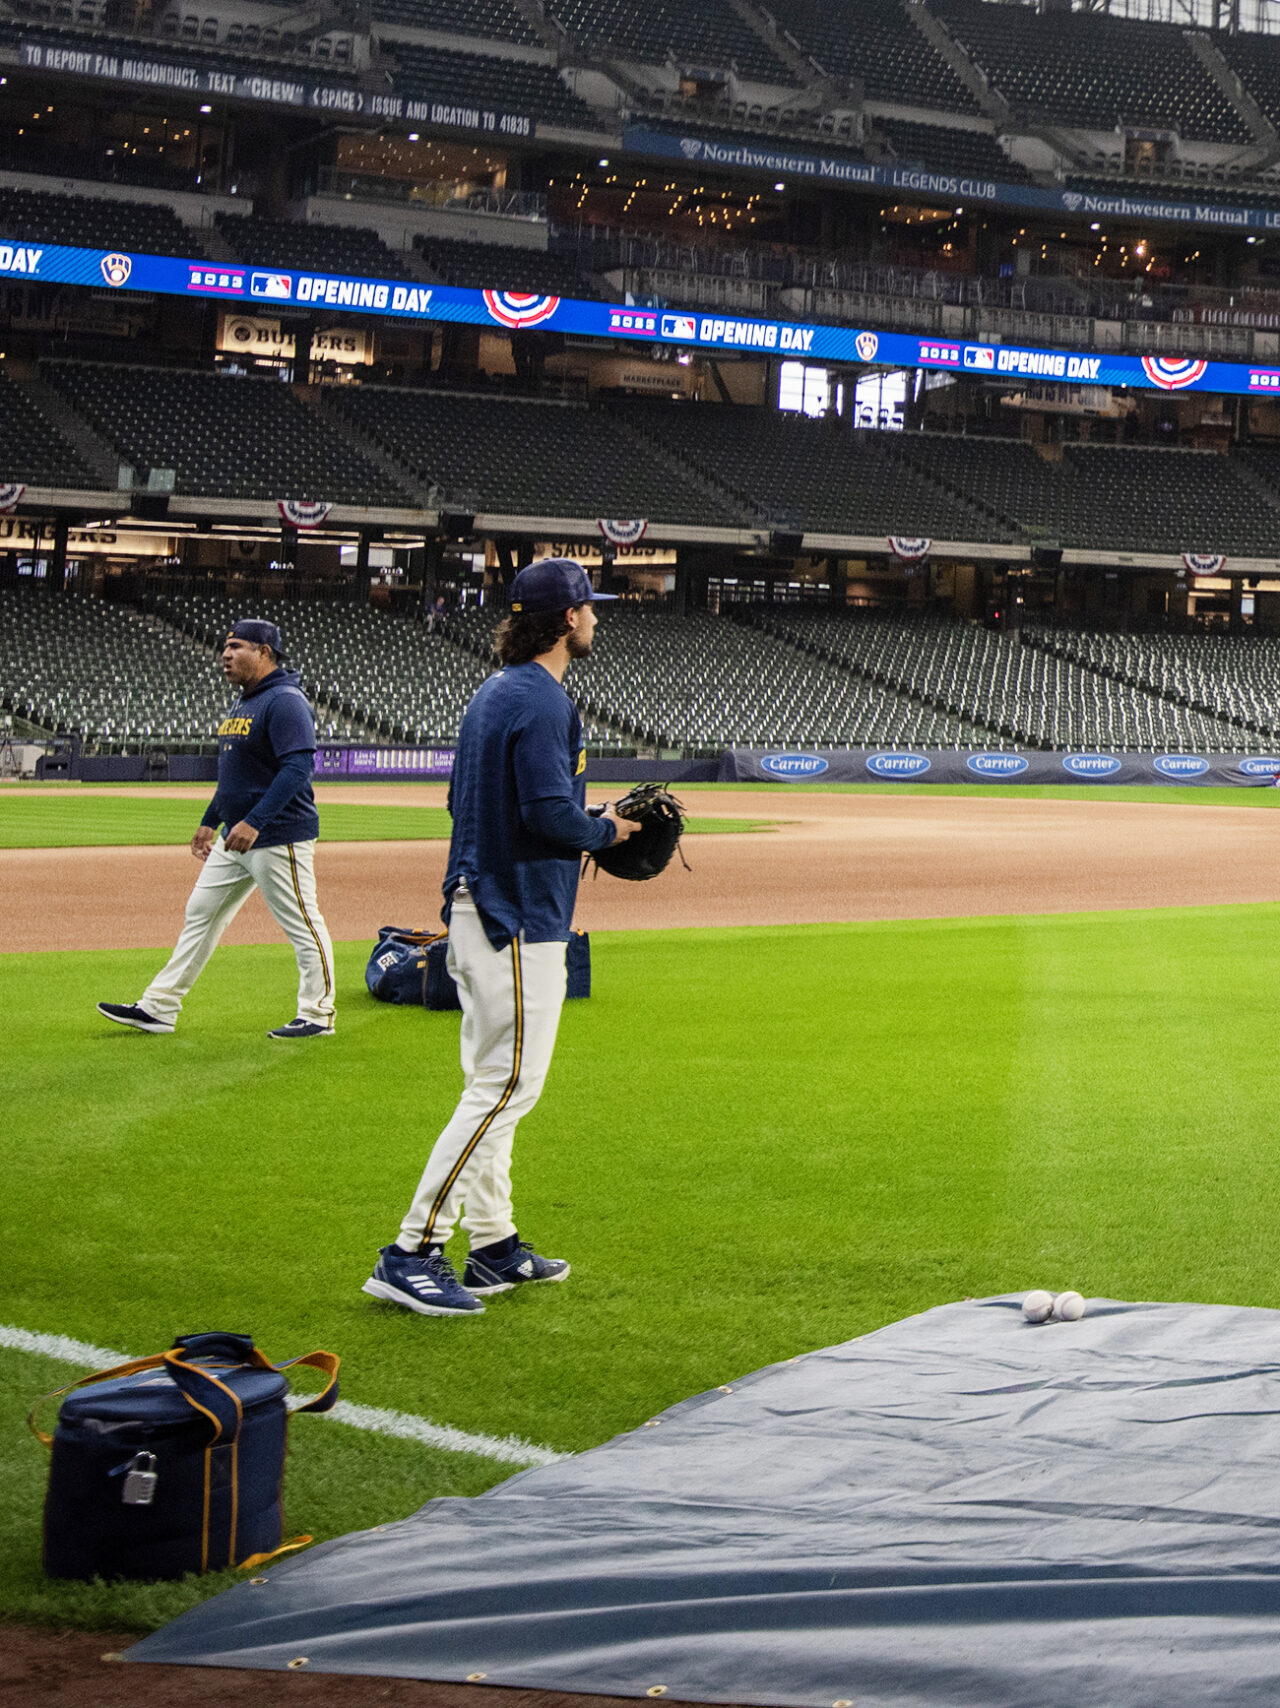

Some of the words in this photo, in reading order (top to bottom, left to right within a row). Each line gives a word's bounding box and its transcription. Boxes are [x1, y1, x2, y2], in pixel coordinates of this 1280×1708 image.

[25, 46, 41, 66] TO
[45, 48, 92, 75] REPORT
[94, 54, 118, 77] FAN
[207, 71, 236, 93] TEXT
[371, 95, 402, 118] ISSUE
[406, 100, 428, 121] AND
[430, 103, 479, 129] LOCATION
[482, 112, 496, 131] TO
[499, 114, 531, 137] 41835
[703, 144, 816, 175] Northwestern
[819, 159, 876, 184] Mutual
[892, 172, 958, 195] LEGENDS
[959, 179, 997, 200] CLUB
[1083, 197, 1192, 222] Northwestern
[1194, 207, 1249, 226] Mutual
[296, 276, 390, 309] OPENING
[391, 286, 432, 314] DAY
[699, 318, 778, 348] OPENING
[779, 326, 815, 351] DAY
[997, 348, 1067, 377] OPENING
[1067, 355, 1102, 379] DAY
[769, 757, 820, 771] Carrier
[875, 757, 924, 770] Carrier
[975, 757, 1021, 770] Carrier
[1070, 757, 1115, 770] Carrier
[1161, 758, 1203, 771] Carrier
